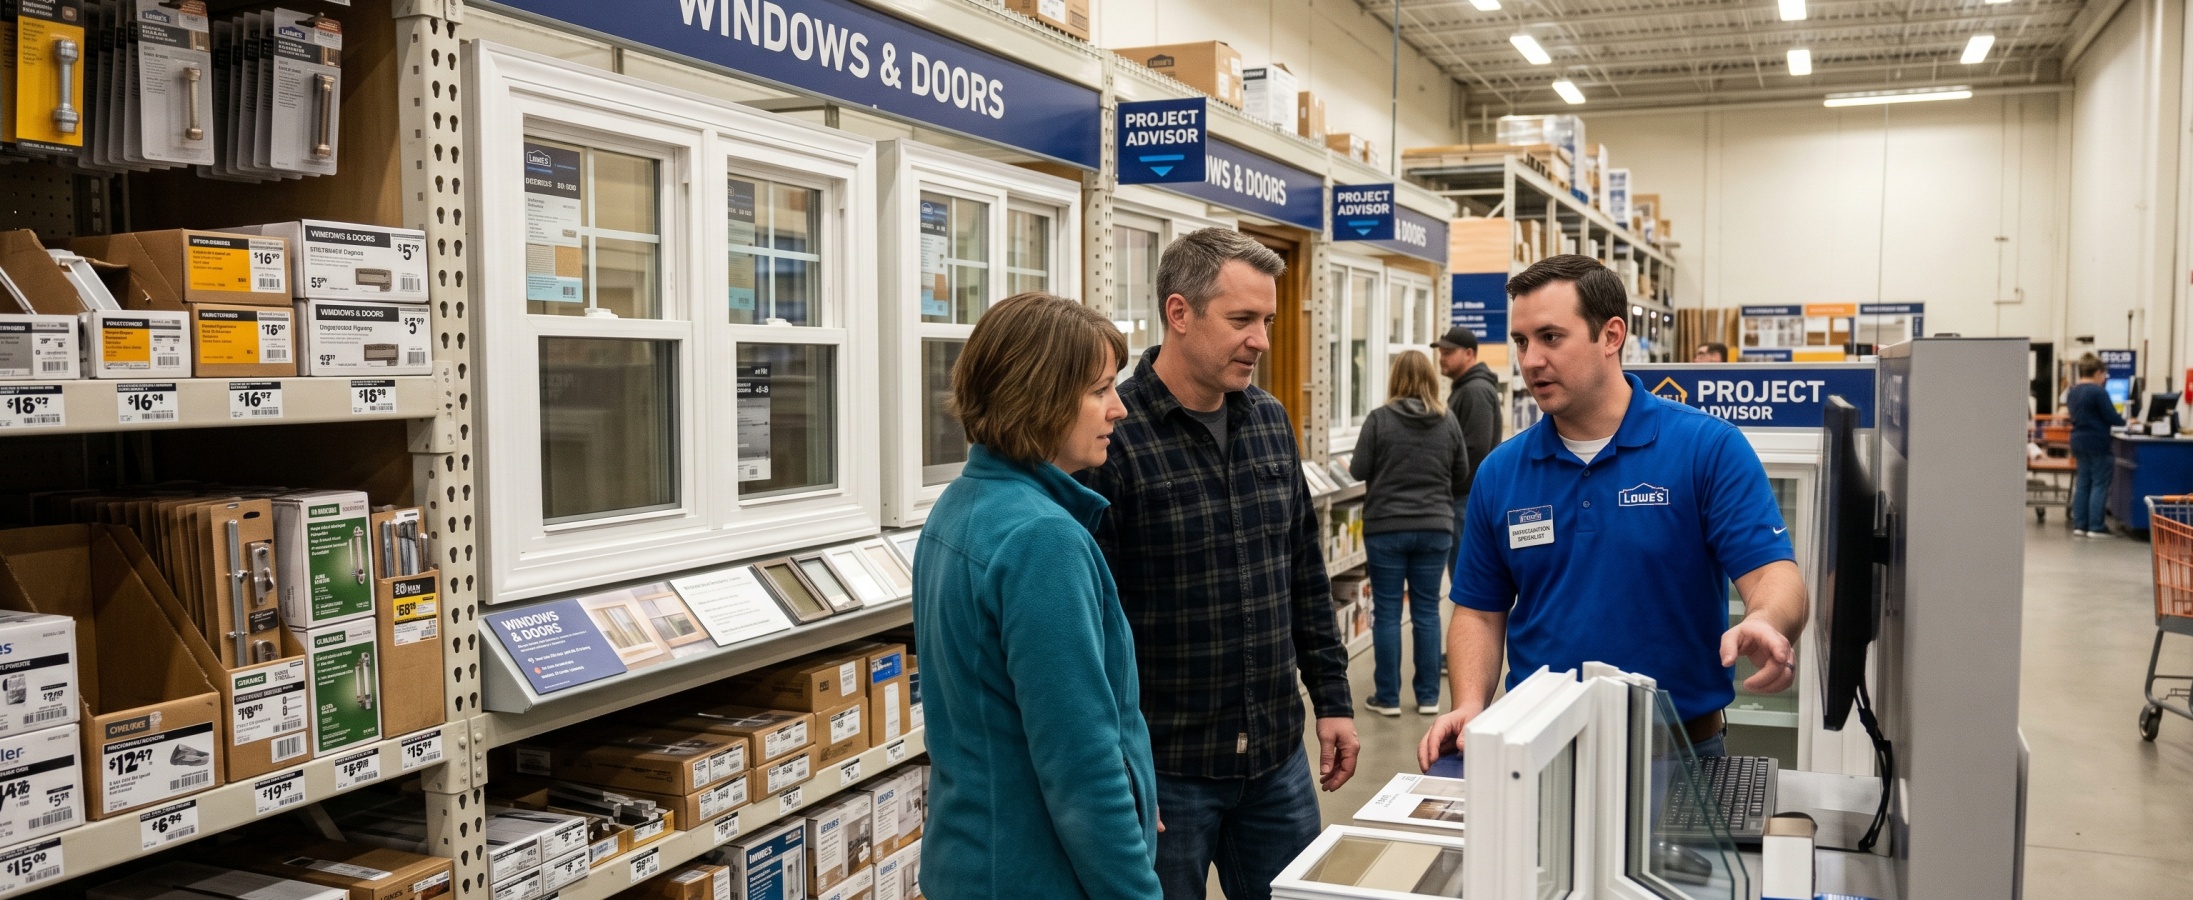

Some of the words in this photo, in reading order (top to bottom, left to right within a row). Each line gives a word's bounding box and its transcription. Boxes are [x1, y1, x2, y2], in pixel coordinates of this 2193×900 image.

[680, 0, 869, 79] WINDOWS
[879, 42, 902, 90] &
[911, 51, 1005, 119] DOORS
[1125, 110, 1199, 128] PROJECT
[1125, 128, 1199, 147] ADVISOR
[1234, 164, 1244, 193] &
[1246, 168, 1287, 206] DOORS
[1337, 190, 1390, 203] PROJECT
[1337, 203, 1390, 216] ADVISOR
[346, 233, 352, 241] &
[352, 234, 375, 243] DOORS
[355, 310, 362, 318] &
[362, 310, 384, 319] DOORS
[1698, 381, 1825, 403] PROJECT
[1624, 491, 1664, 504] LOWE'S
[501, 611, 560, 631] WINDOWS
[511, 632, 523, 642] &
[521, 623, 563, 641] DOORS
